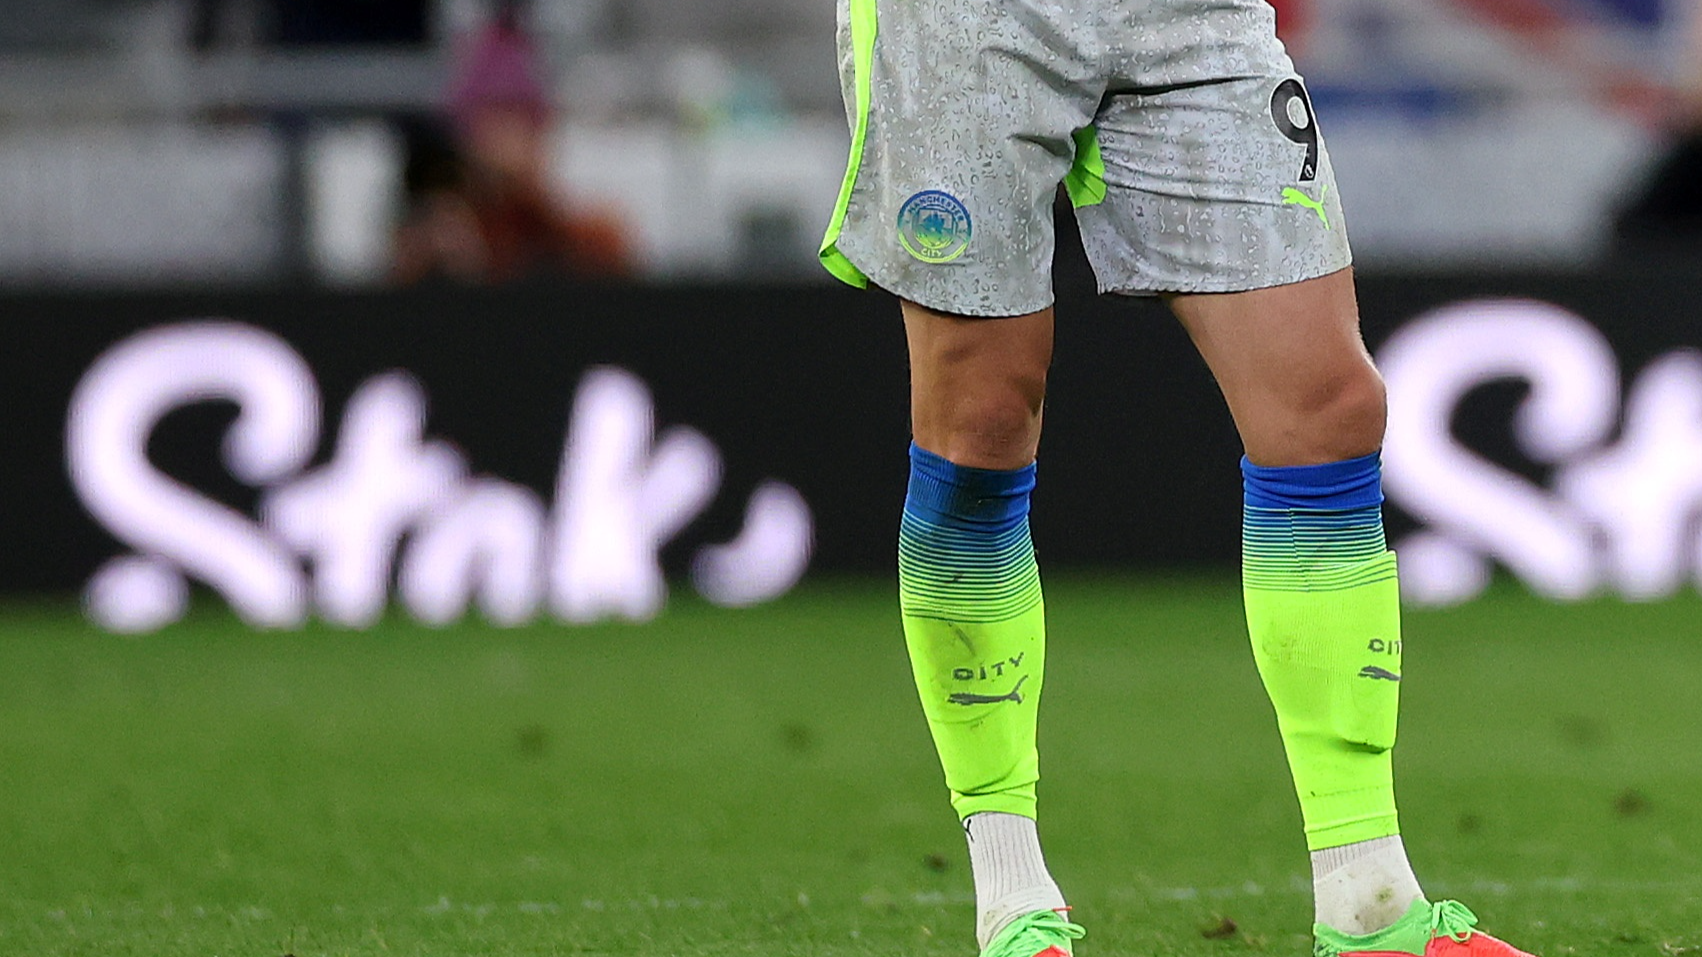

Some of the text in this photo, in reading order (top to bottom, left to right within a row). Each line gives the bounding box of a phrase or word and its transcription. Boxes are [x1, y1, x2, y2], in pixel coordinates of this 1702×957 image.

[1269, 77, 1320, 182] 9
[921, 248, 943, 257] CITY
[1367, 638, 1401, 655] CIT
[952, 651, 1025, 681] CITY
